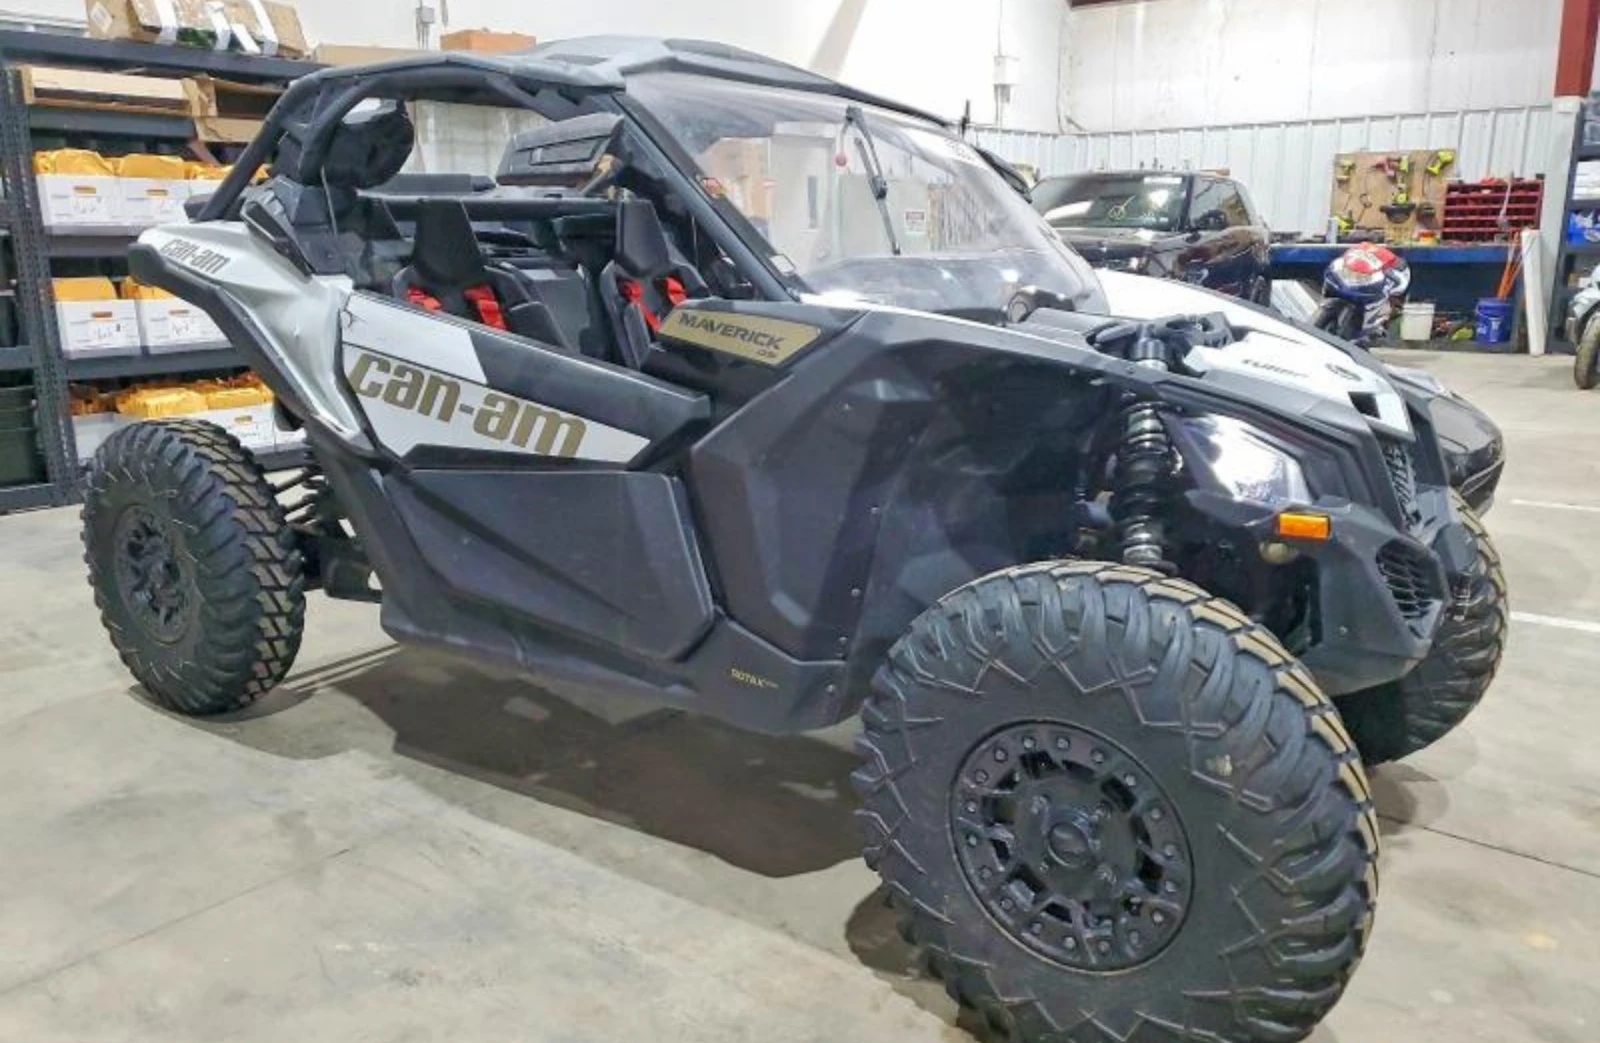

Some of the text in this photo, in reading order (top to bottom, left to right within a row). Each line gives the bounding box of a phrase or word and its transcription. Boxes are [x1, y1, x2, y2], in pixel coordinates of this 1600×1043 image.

[160, 239, 231, 274] can-am
[679, 312, 784, 350] MAVERICK
[350, 353, 586, 458] can-am
